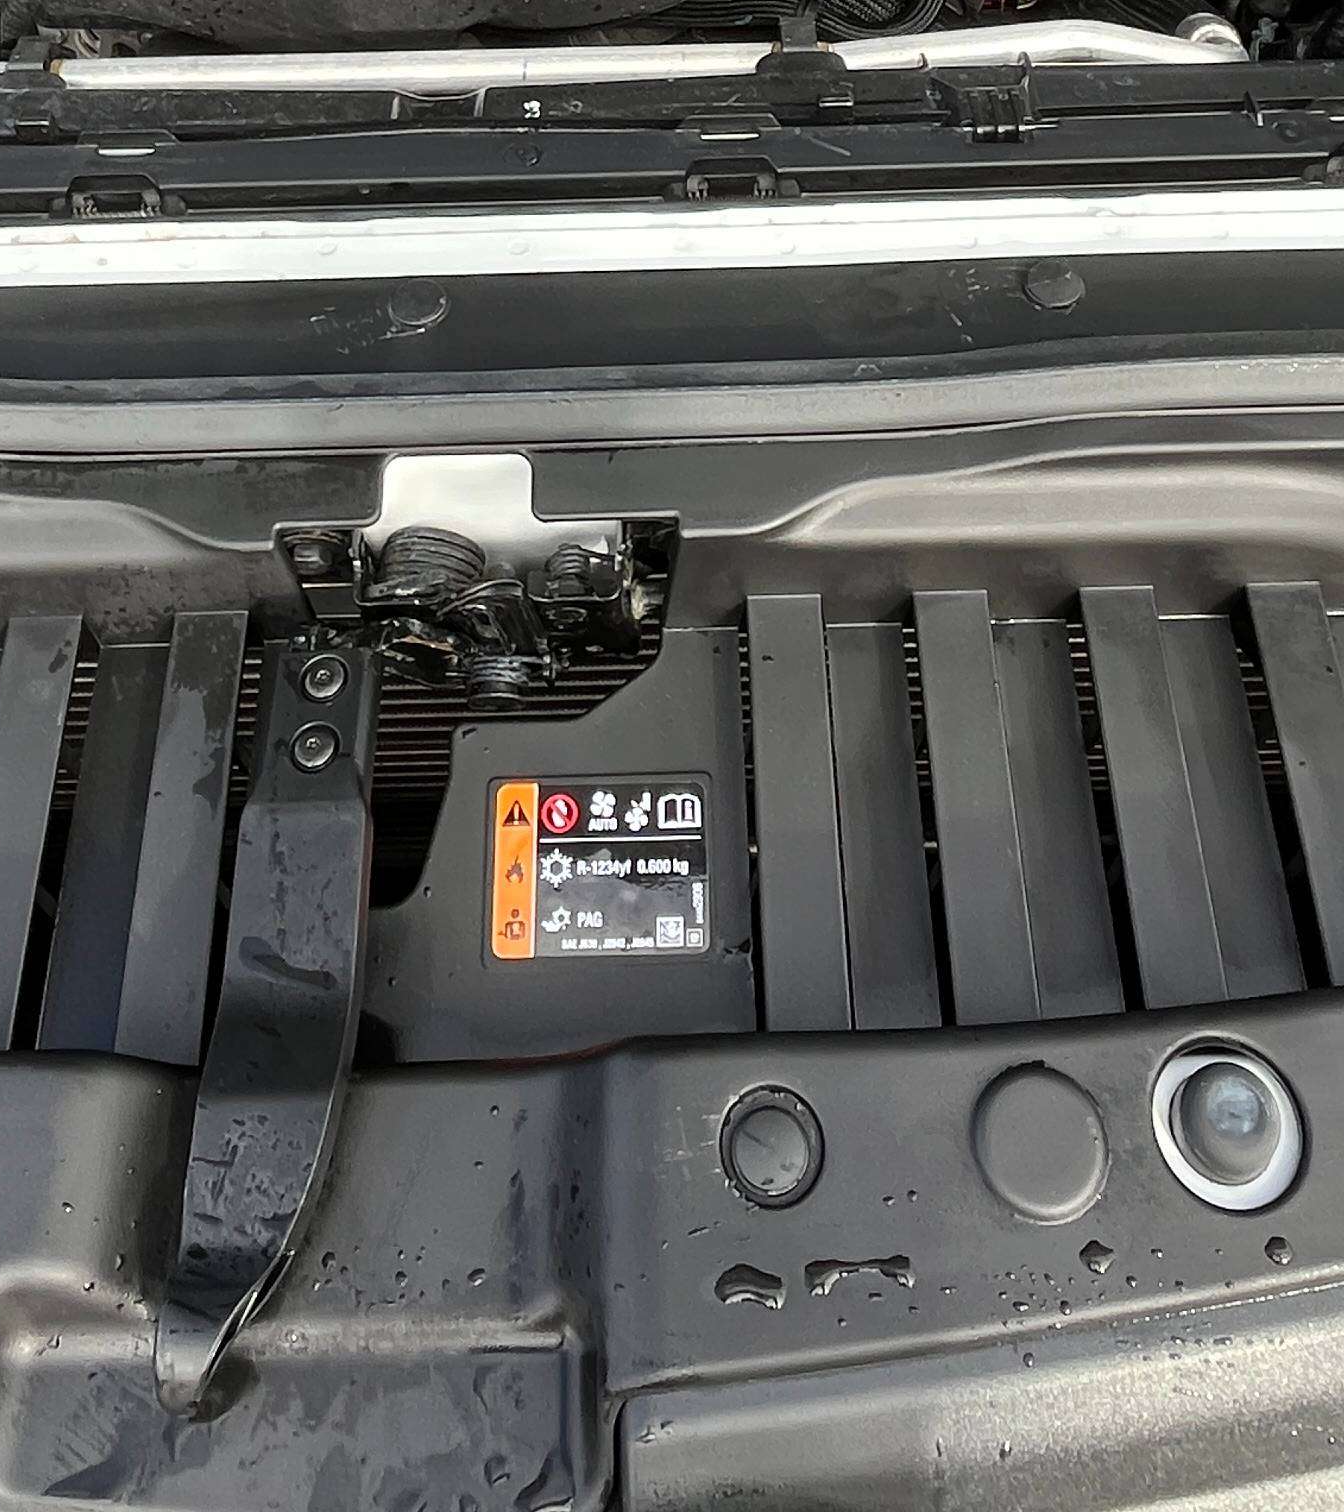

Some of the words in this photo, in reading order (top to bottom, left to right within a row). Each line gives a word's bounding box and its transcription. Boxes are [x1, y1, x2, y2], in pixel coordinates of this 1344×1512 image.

[588, 817, 618, 832] AUTO
[576, 859, 632, 878] R-1234yf
[636, 858, 671, 875] 0.600
[672, 857, 689, 876] kg
[576, 910, 604, 928] PAG
